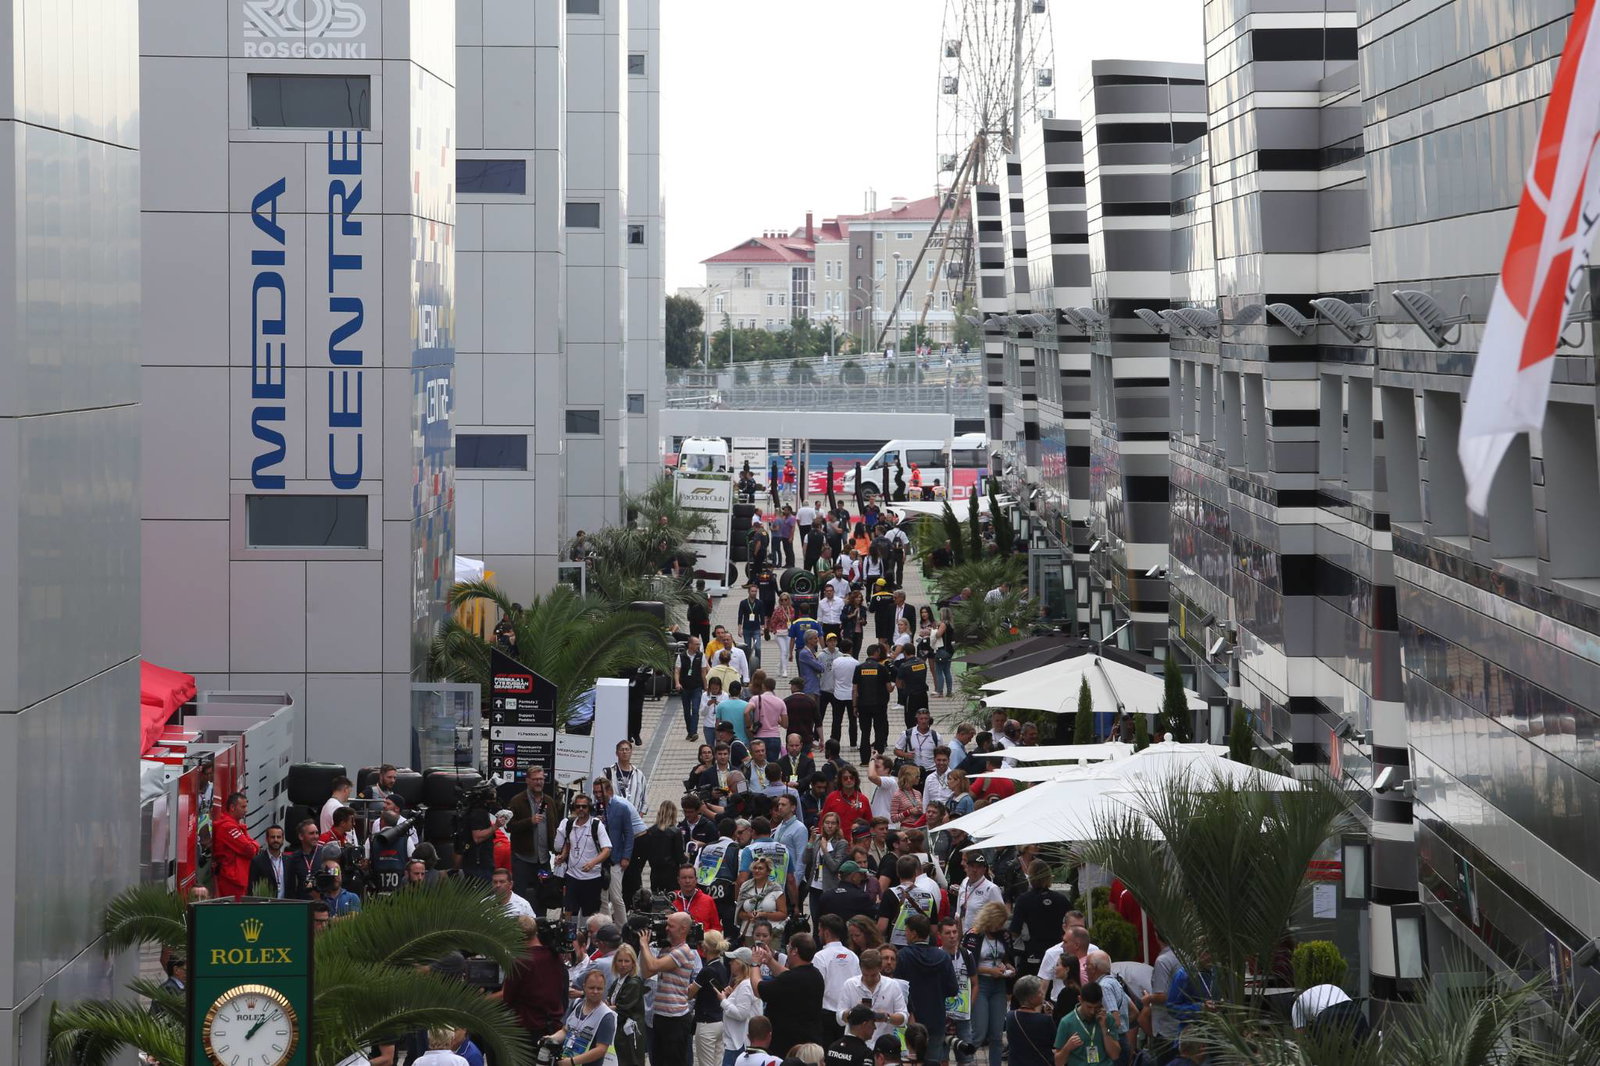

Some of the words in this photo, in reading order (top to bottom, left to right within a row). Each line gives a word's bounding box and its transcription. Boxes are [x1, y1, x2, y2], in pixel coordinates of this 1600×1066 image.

[243, 41, 367, 59] ROSGONKI
[328, 130, 364, 490] CENTRE
[251, 176, 286, 490] MEDIA
[380, 872, 398, 887] 170
[706, 884, 724, 899] 228
[210, 947, 293, 965] ROLEX
